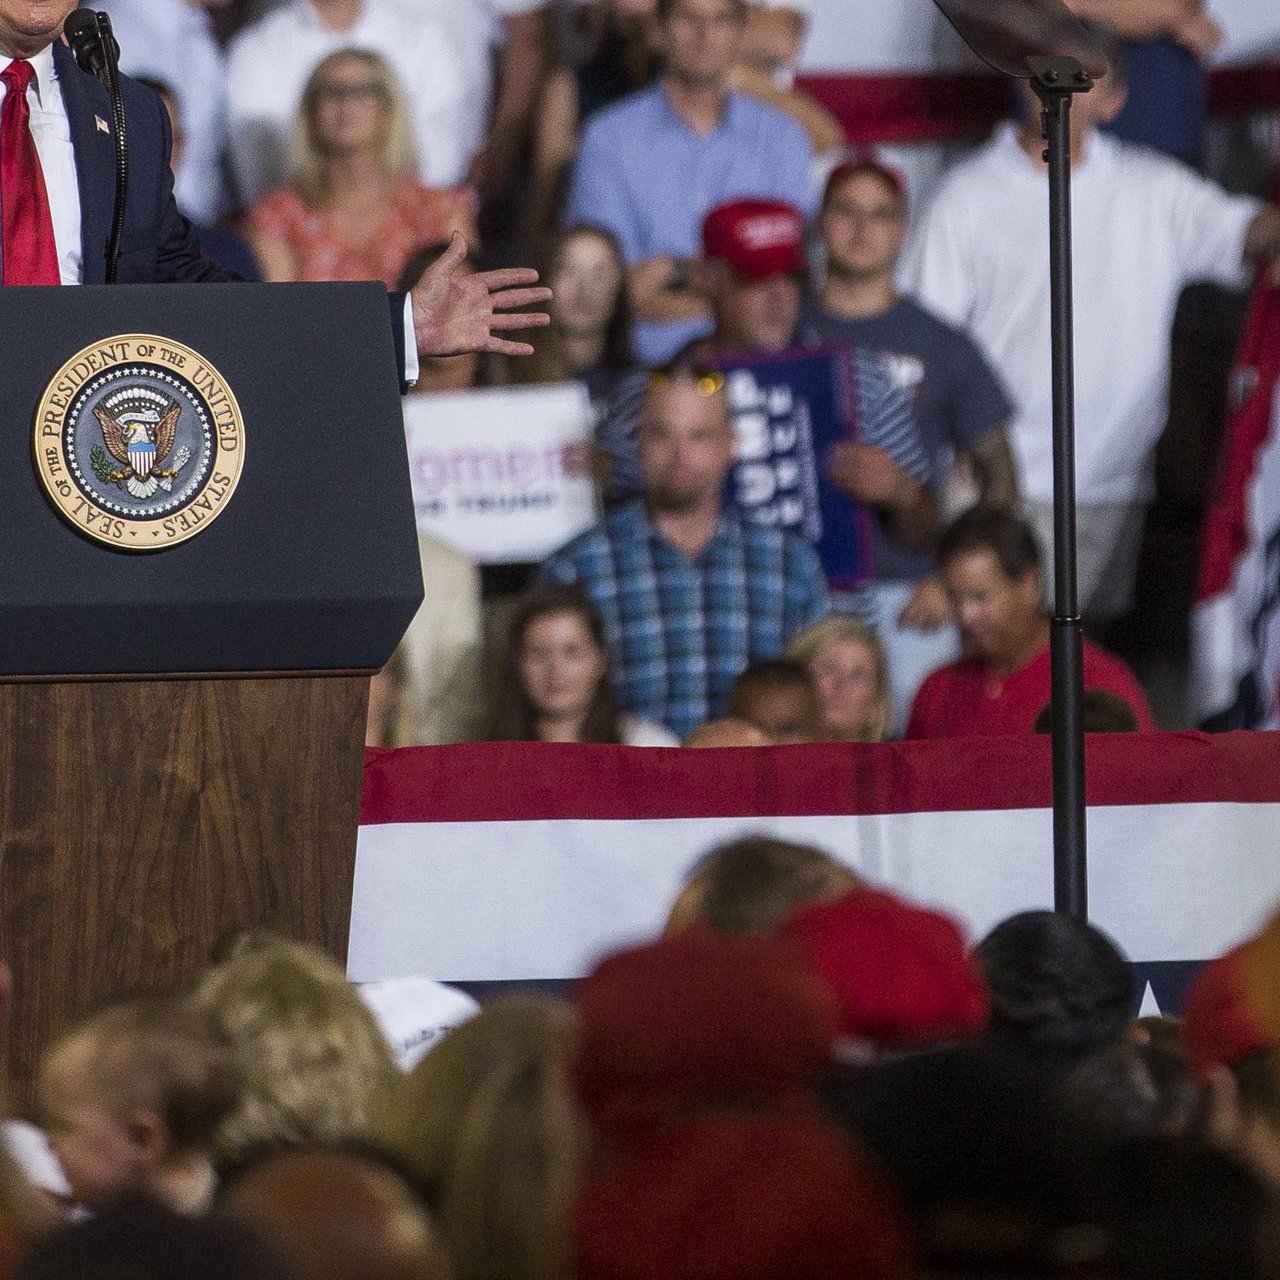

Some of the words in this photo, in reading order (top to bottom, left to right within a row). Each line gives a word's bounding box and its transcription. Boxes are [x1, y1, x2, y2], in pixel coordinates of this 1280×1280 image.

[137, 343, 156, 357] OF
[160, 348, 187, 369] THE
[42, 342, 131, 439] PRESIDENT
[191, 365, 238, 452] UNITED
[46, 446, 63, 477] THE
[55, 479, 72, 497] OF
[163, 471, 232, 538] STATES
[72, 496, 125, 539] SEAL
